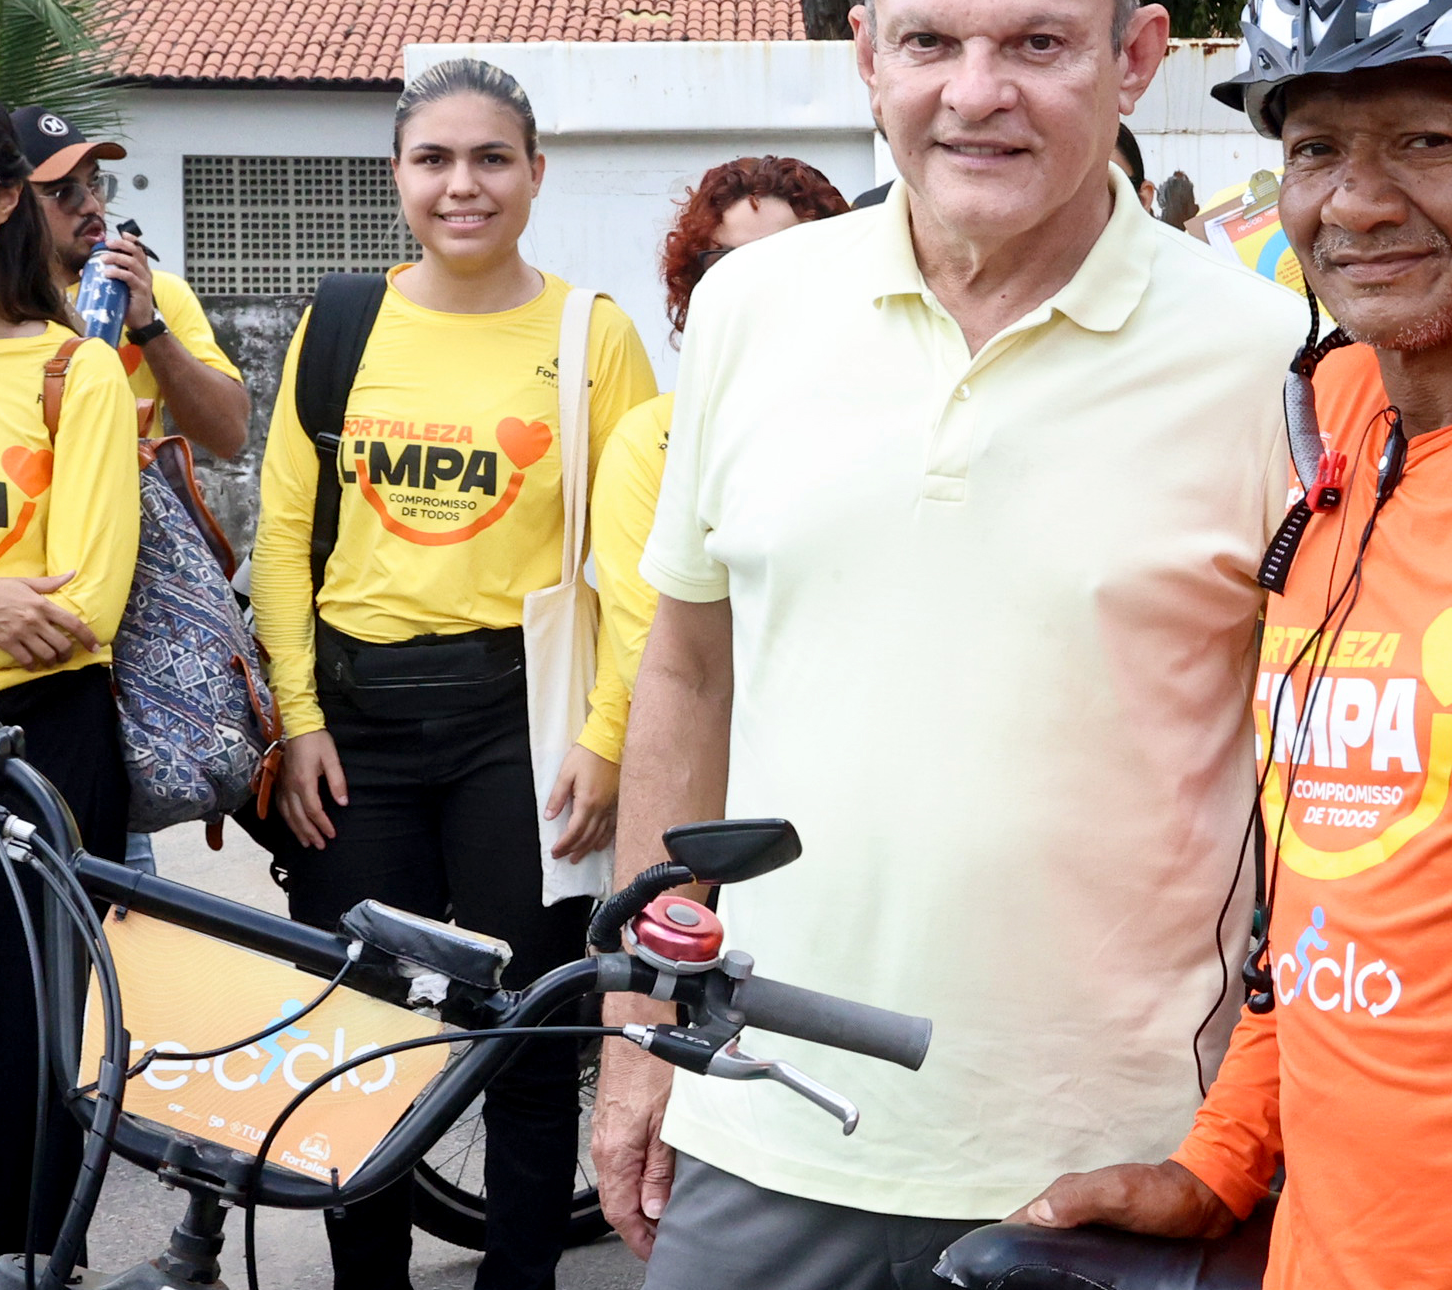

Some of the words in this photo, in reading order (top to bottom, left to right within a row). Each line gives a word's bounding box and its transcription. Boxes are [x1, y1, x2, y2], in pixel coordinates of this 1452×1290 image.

[343, 418, 473, 444] FORTALEZA
[388, 492, 478, 510] COMPROMISSO
[401, 506, 418, 517] DE
[420, 508, 461, 521] TODOS
[1260, 625, 1402, 669] ORTALEZA
[1293, 779, 1404, 805] COMPROMISSO
[1303, 806, 1326, 824] DE
[1326, 807, 1380, 828] TODOS
